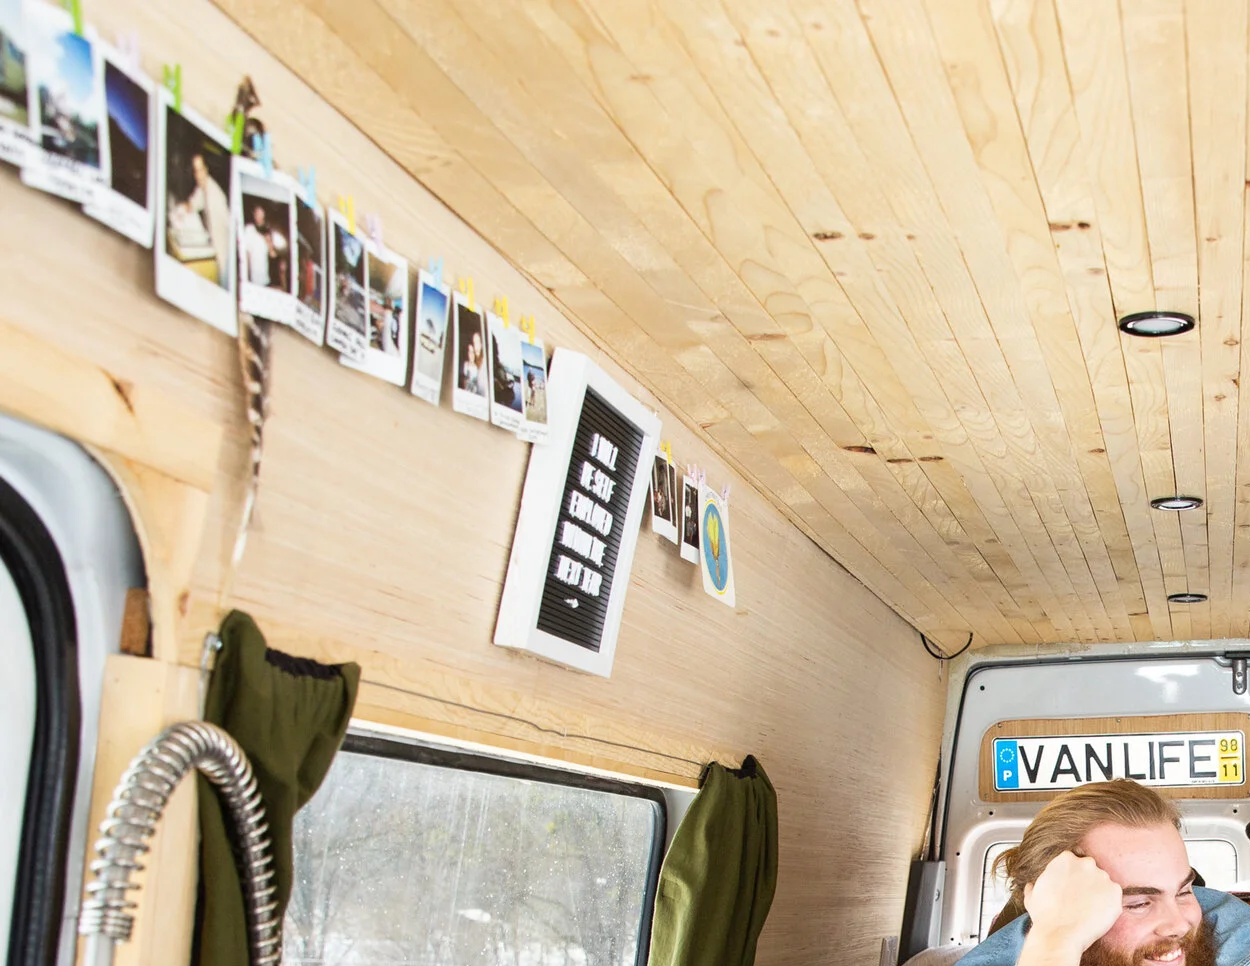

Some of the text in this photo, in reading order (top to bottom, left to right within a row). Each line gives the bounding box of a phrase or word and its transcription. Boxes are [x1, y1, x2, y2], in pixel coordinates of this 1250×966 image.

[1220, 739, 1238, 752] 98
[1003, 739, 1217, 783] P VANLIFE
[1222, 763, 1238, 777] 11
